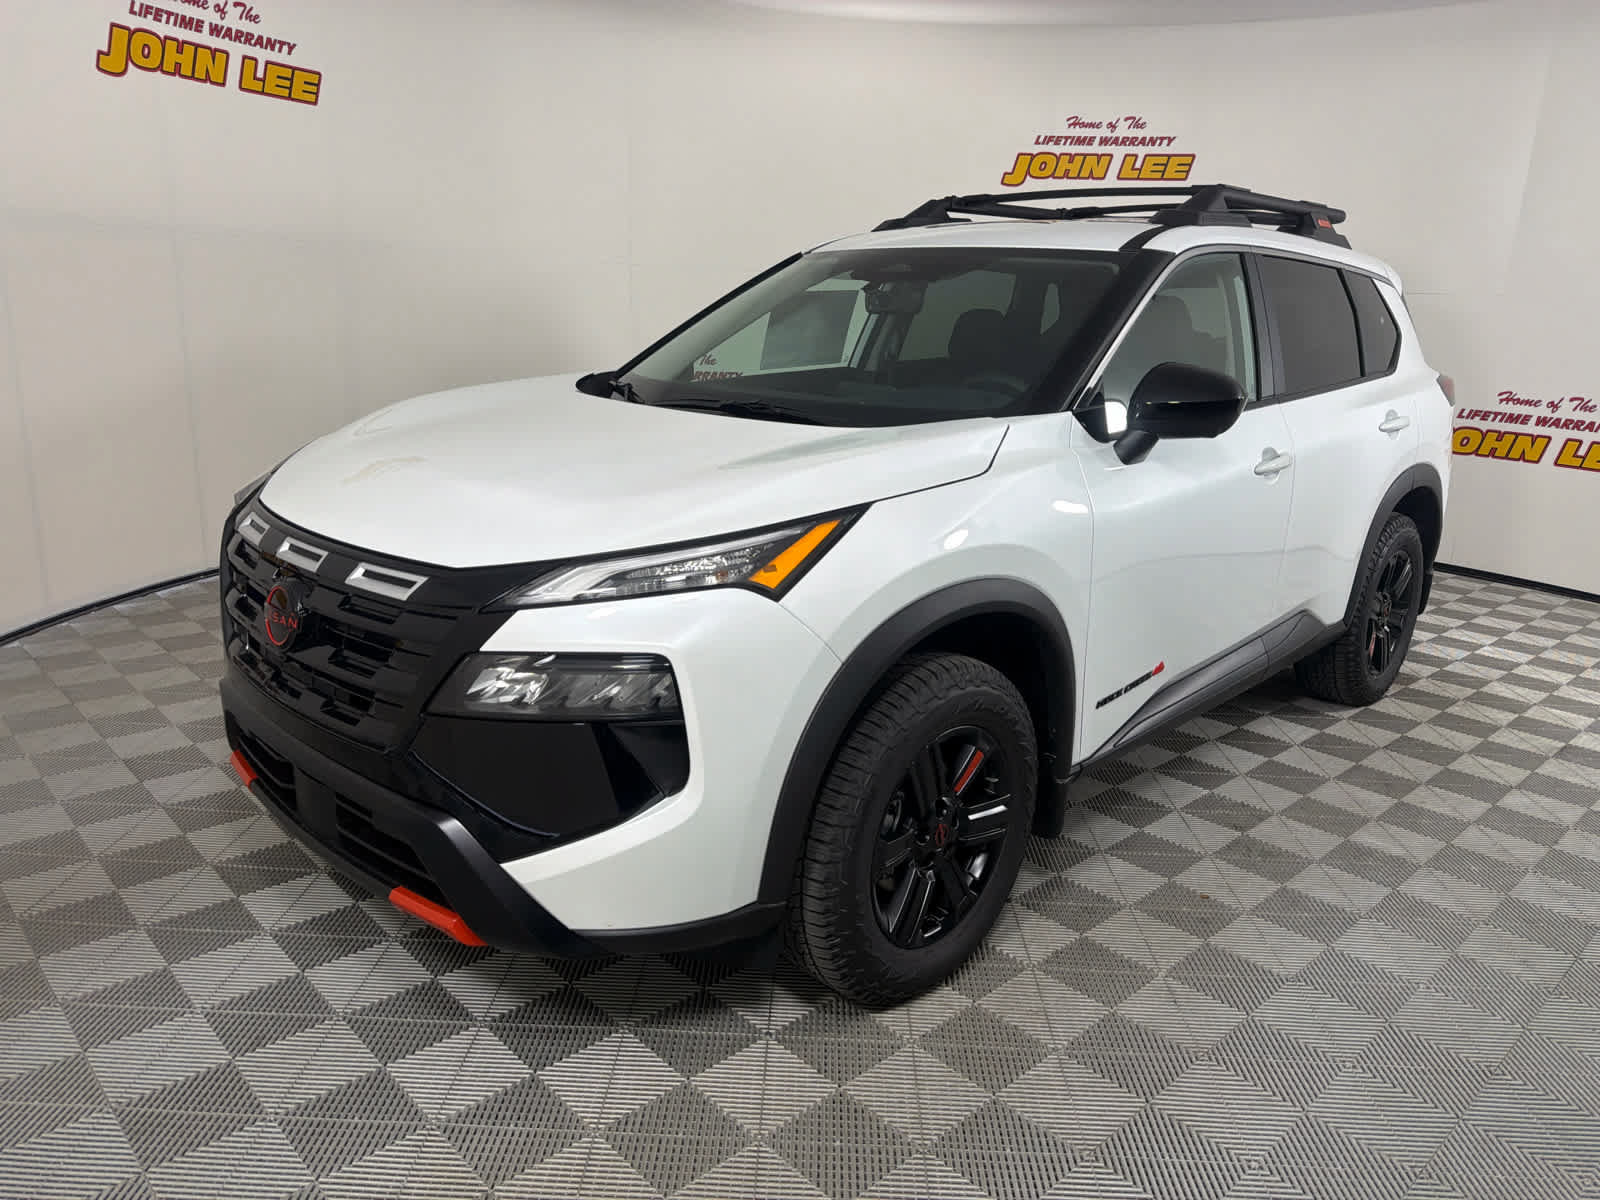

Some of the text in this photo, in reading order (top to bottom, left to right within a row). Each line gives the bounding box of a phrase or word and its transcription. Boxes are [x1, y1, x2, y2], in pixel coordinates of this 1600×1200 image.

[213, 0, 228, 20] of
[233, 1, 262, 24] The
[128, 0, 297, 56] LIFETIME WARRANTY
[96, 22, 322, 106] JOHN LEE
[1066, 116, 1147, 133] Home of The
[1034, 135, 1176, 147] LIFETIME WARRANTY
[1001, 152, 1196, 186] JOHN LEE
[1497, 391, 1598, 414] Home of The
[1456, 408, 1533, 426] LIFETIME
[1452, 426, 1552, 464] OHN
